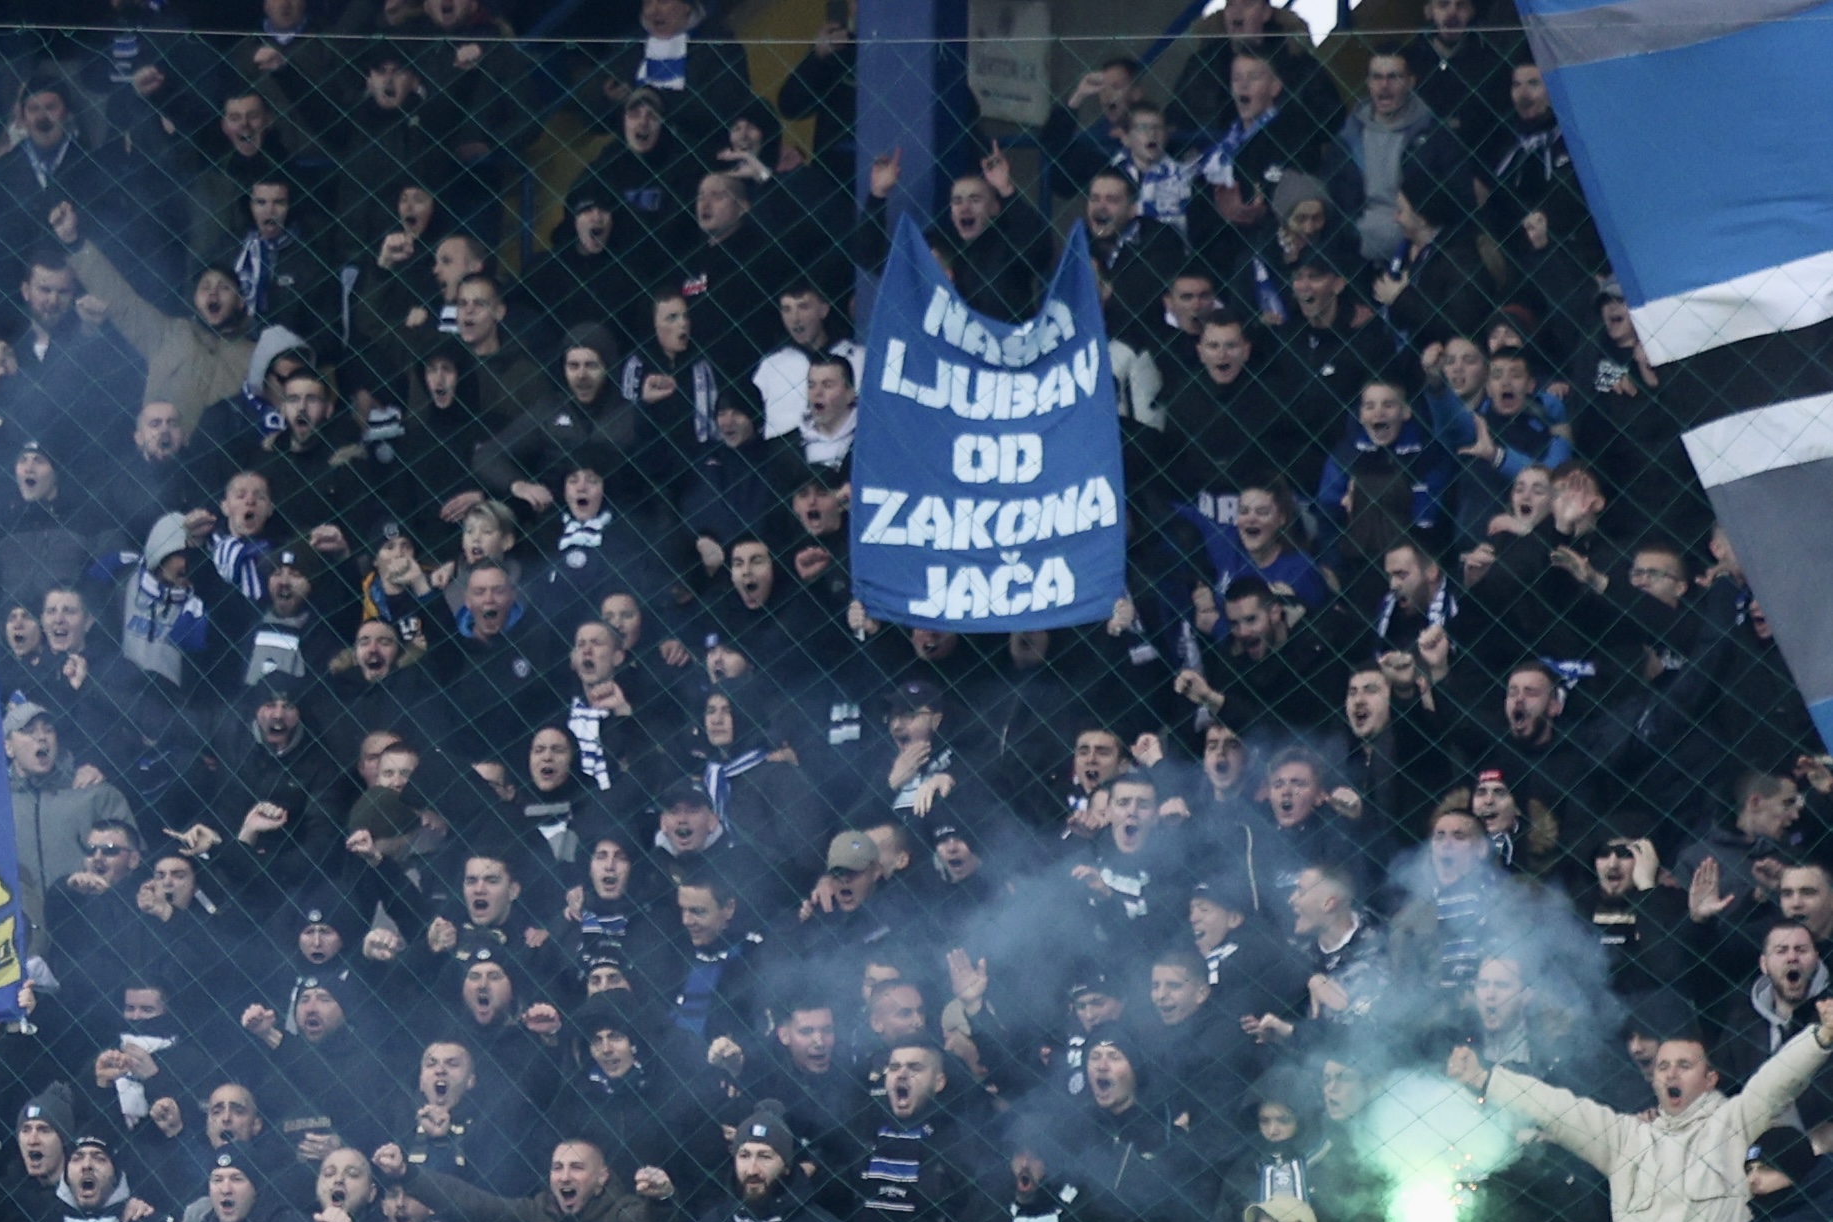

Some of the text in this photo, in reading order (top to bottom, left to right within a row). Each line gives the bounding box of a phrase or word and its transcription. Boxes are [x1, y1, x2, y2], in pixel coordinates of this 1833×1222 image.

[881, 338, 1099, 421] LJUBAV
[953, 433, 1043, 484] OD
[859, 475, 1118, 550] ZAKONA
[908, 551, 1076, 620] JAČA
